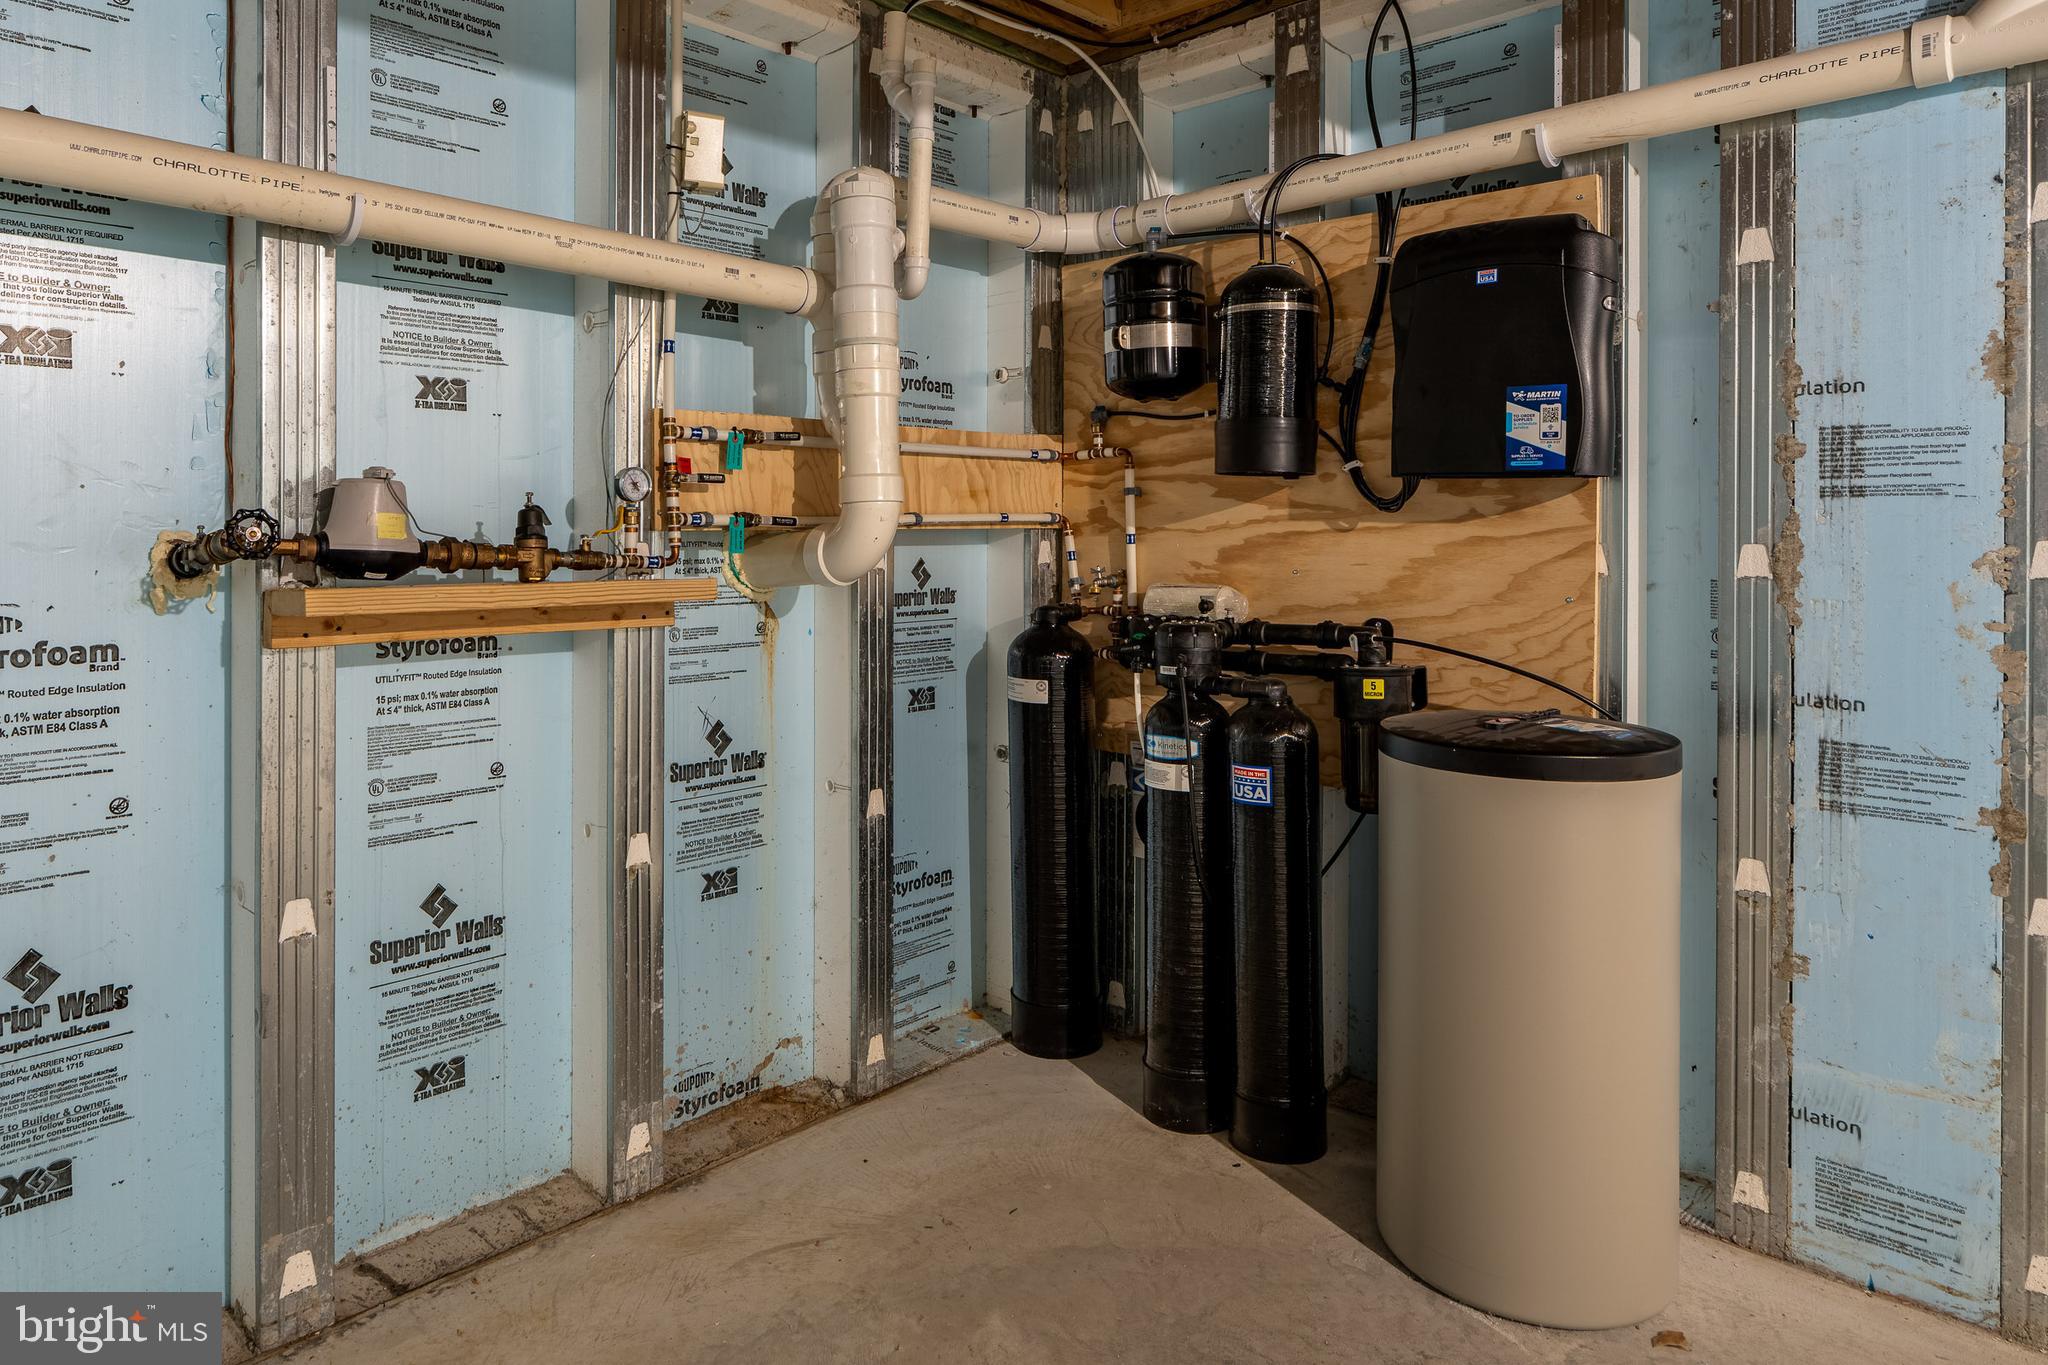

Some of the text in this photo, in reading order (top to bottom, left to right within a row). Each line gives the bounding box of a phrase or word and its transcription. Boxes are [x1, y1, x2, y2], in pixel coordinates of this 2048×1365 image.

[406, 6, 426, 20] thick,
[428, 14, 450, 26] ASTM
[451, 20, 464, 30] E84
[466, 23, 485, 36] Class
[486, 30, 492, 38] A
[442, 7, 462, 18] water
[464, 13, 500, 30] absorption
[1759, 58, 1849, 84] CHARLOTTE
[1859, 46, 1902, 62] PIPE
[69, 144, 301, 192] WWW.CHARLOTTEPIPE.COM CHARLOTTE PIPE
[732, 182, 766, 208] Walls
[424, 210, 445, 219] CELLULAR
[30, 222, 65, 233] BARRIER
[84, 230, 124, 241] REQUIRED
[66, 236, 84, 244] 1715
[22, 274, 61, 286] Builder
[74, 281, 110, 292] Owner:
[393, 264, 492, 285] www.superiorwalls.com
[47, 296, 128, 310] construction details.
[66, 290, 100, 300] Superior
[413, 288, 438, 298] THERMAL
[439, 292, 462, 300] BARRIER
[474, 298, 502, 306] REQUIRED
[413, 296, 430, 304] Tested
[393, 331, 422, 340] NOTICE
[433, 335, 460, 344] Builder
[468, 338, 492, 348] Owner:
[394, 339, 486, 355] essential Superior
[901, 376, 952, 394] yrofoam
[1527, 390, 1561, 398] MARTIN
[694, 566, 709, 575] thick,
[930, 586, 956, 606] Walls
[376, 636, 498, 662] Styrofoam
[478, 652, 498, 660] Brand
[89, 663, 120, 672] Brand
[423, 670, 448, 680] Routed
[450, 670, 468, 678] Edge
[468, 667, 502, 676] Insulation
[8, 682, 126, 698] Routed Edge Insulation
[376, 686, 498, 705] 15 psi; max 0.1% water absorption
[1370, 682, 1376, 690] 5
[4, 705, 120, 724] 0.1% water absorption
[376, 697, 490, 716] At thick, ASTM E84 Class A
[11, 718, 108, 737] ASTM E84 Class A
[1158, 742, 1188, 751] Kinetico
[670, 750, 765, 783] Superior Walls
[684, 774, 756, 793] www.superiorwalls.com
[1234, 784, 1266, 800] USA
[684, 838, 706, 848] NOTICE
[714, 833, 732, 843] Builder
[370, 914, 504, 965] Superior Walls
[391, 944, 491, 975] www.superiorwalls.com
[411, 980, 436, 990] THERMAL
[437, 974, 460, 984] BARRIER
[461, 970, 472, 978] NOT
[428, 976, 474, 994] Per 1715
[57, 984, 129, 1022] Walls
[391, 1008, 491, 1041] NOTICE to Builder Owner:
[30, 1042, 124, 1072] BARRIER NOT REQUIRED
[16, 1076, 30, 1084] Per
[66, 1060, 84, 1070] 1715
[678, 1072, 710, 1092] DUPONT
[3, 1104, 124, 1142] that you follow Superior Walls
[8, 1098, 110, 1132] to Builder & Owner:
[33, 1111, 128, 1141] for construction details.
